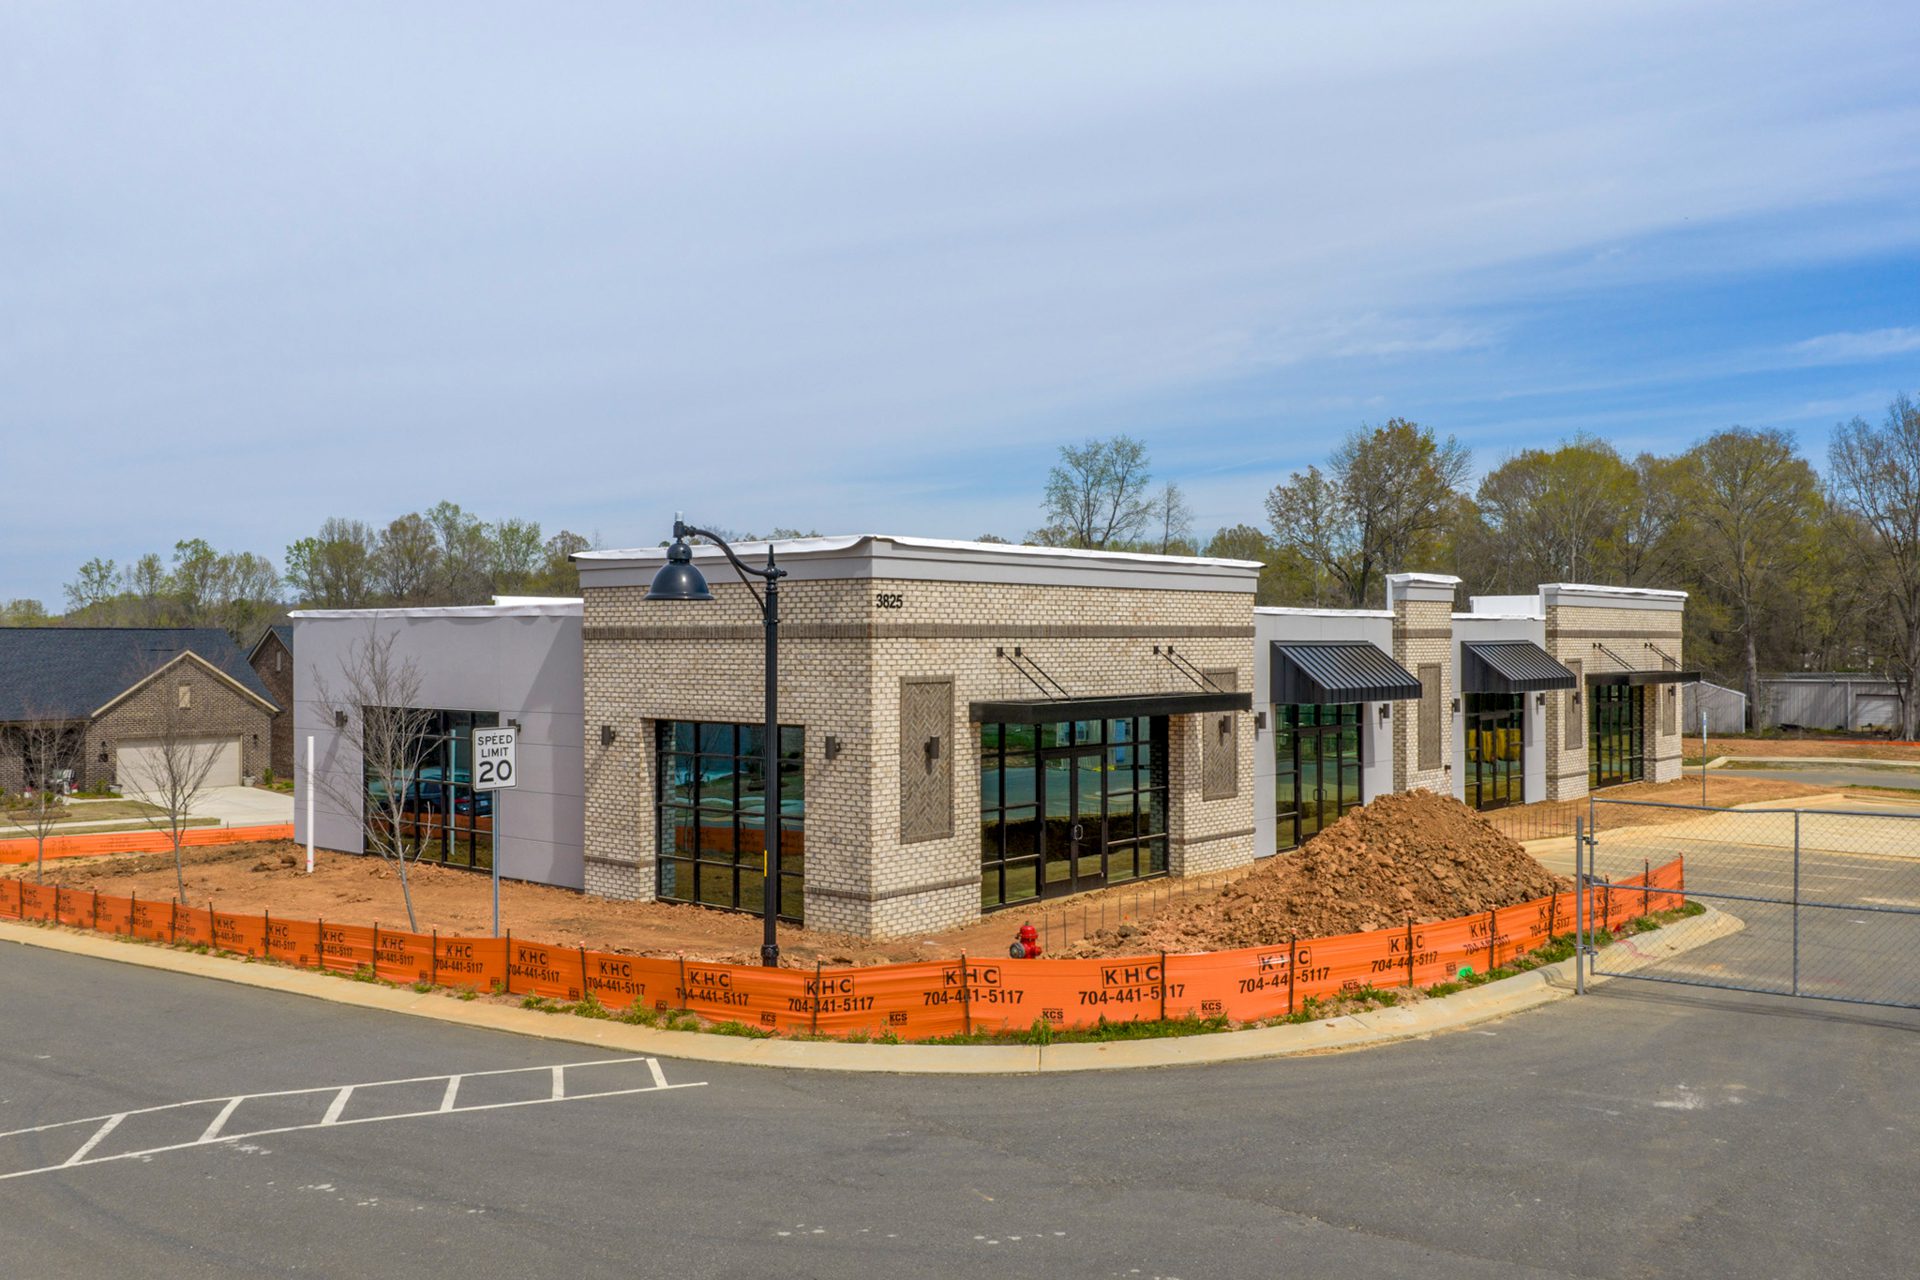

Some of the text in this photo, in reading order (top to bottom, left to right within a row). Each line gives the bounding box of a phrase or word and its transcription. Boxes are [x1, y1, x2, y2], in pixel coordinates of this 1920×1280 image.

[876, 594, 903, 609] 3825
[478, 734, 513, 746] SPEED
[481, 747, 509, 758] LIMIT
[479, 760, 512, 783] 20
[446, 944, 472, 958] KHC
[519, 950, 547, 965] KHC
[600, 962, 630, 977] KHC
[1105, 966, 1160, 985] KHC
[588, 976, 645, 995] 704-441-5117
[690, 971, 729, 988] KHC
[1238, 967, 1330, 994] 704-44-5117
[1042, 1009, 1063, 1019] KCS
[1201, 1002, 1222, 1011] KCS
[761, 1013, 776, 1023] KCS
